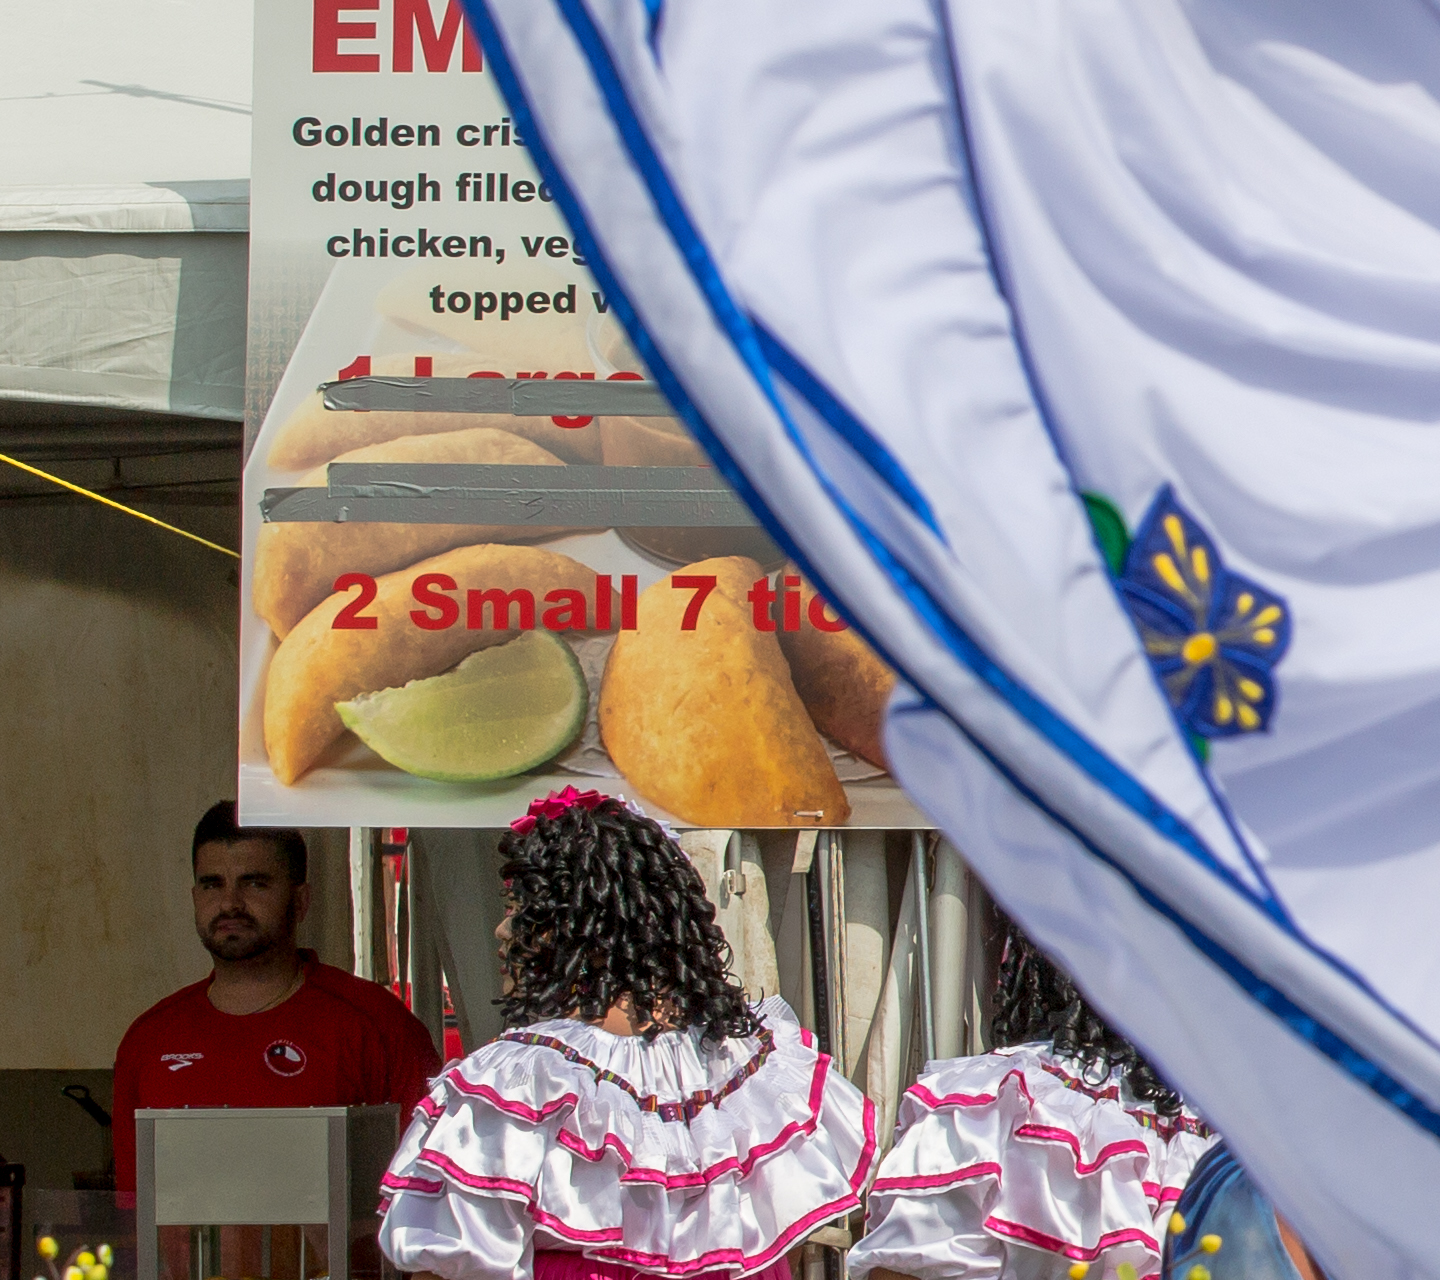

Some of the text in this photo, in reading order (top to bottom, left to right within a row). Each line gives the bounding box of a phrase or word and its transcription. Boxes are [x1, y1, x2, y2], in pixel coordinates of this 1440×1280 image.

[292, 117, 441, 147] Golden
[311, 172, 441, 210] dough
[326, 227, 506, 265] chicken,
[428, 283, 577, 321] topped
[330, 572, 379, 630] 2
[408, 572, 638, 631] Small
[670, 574, 718, 631] 7
